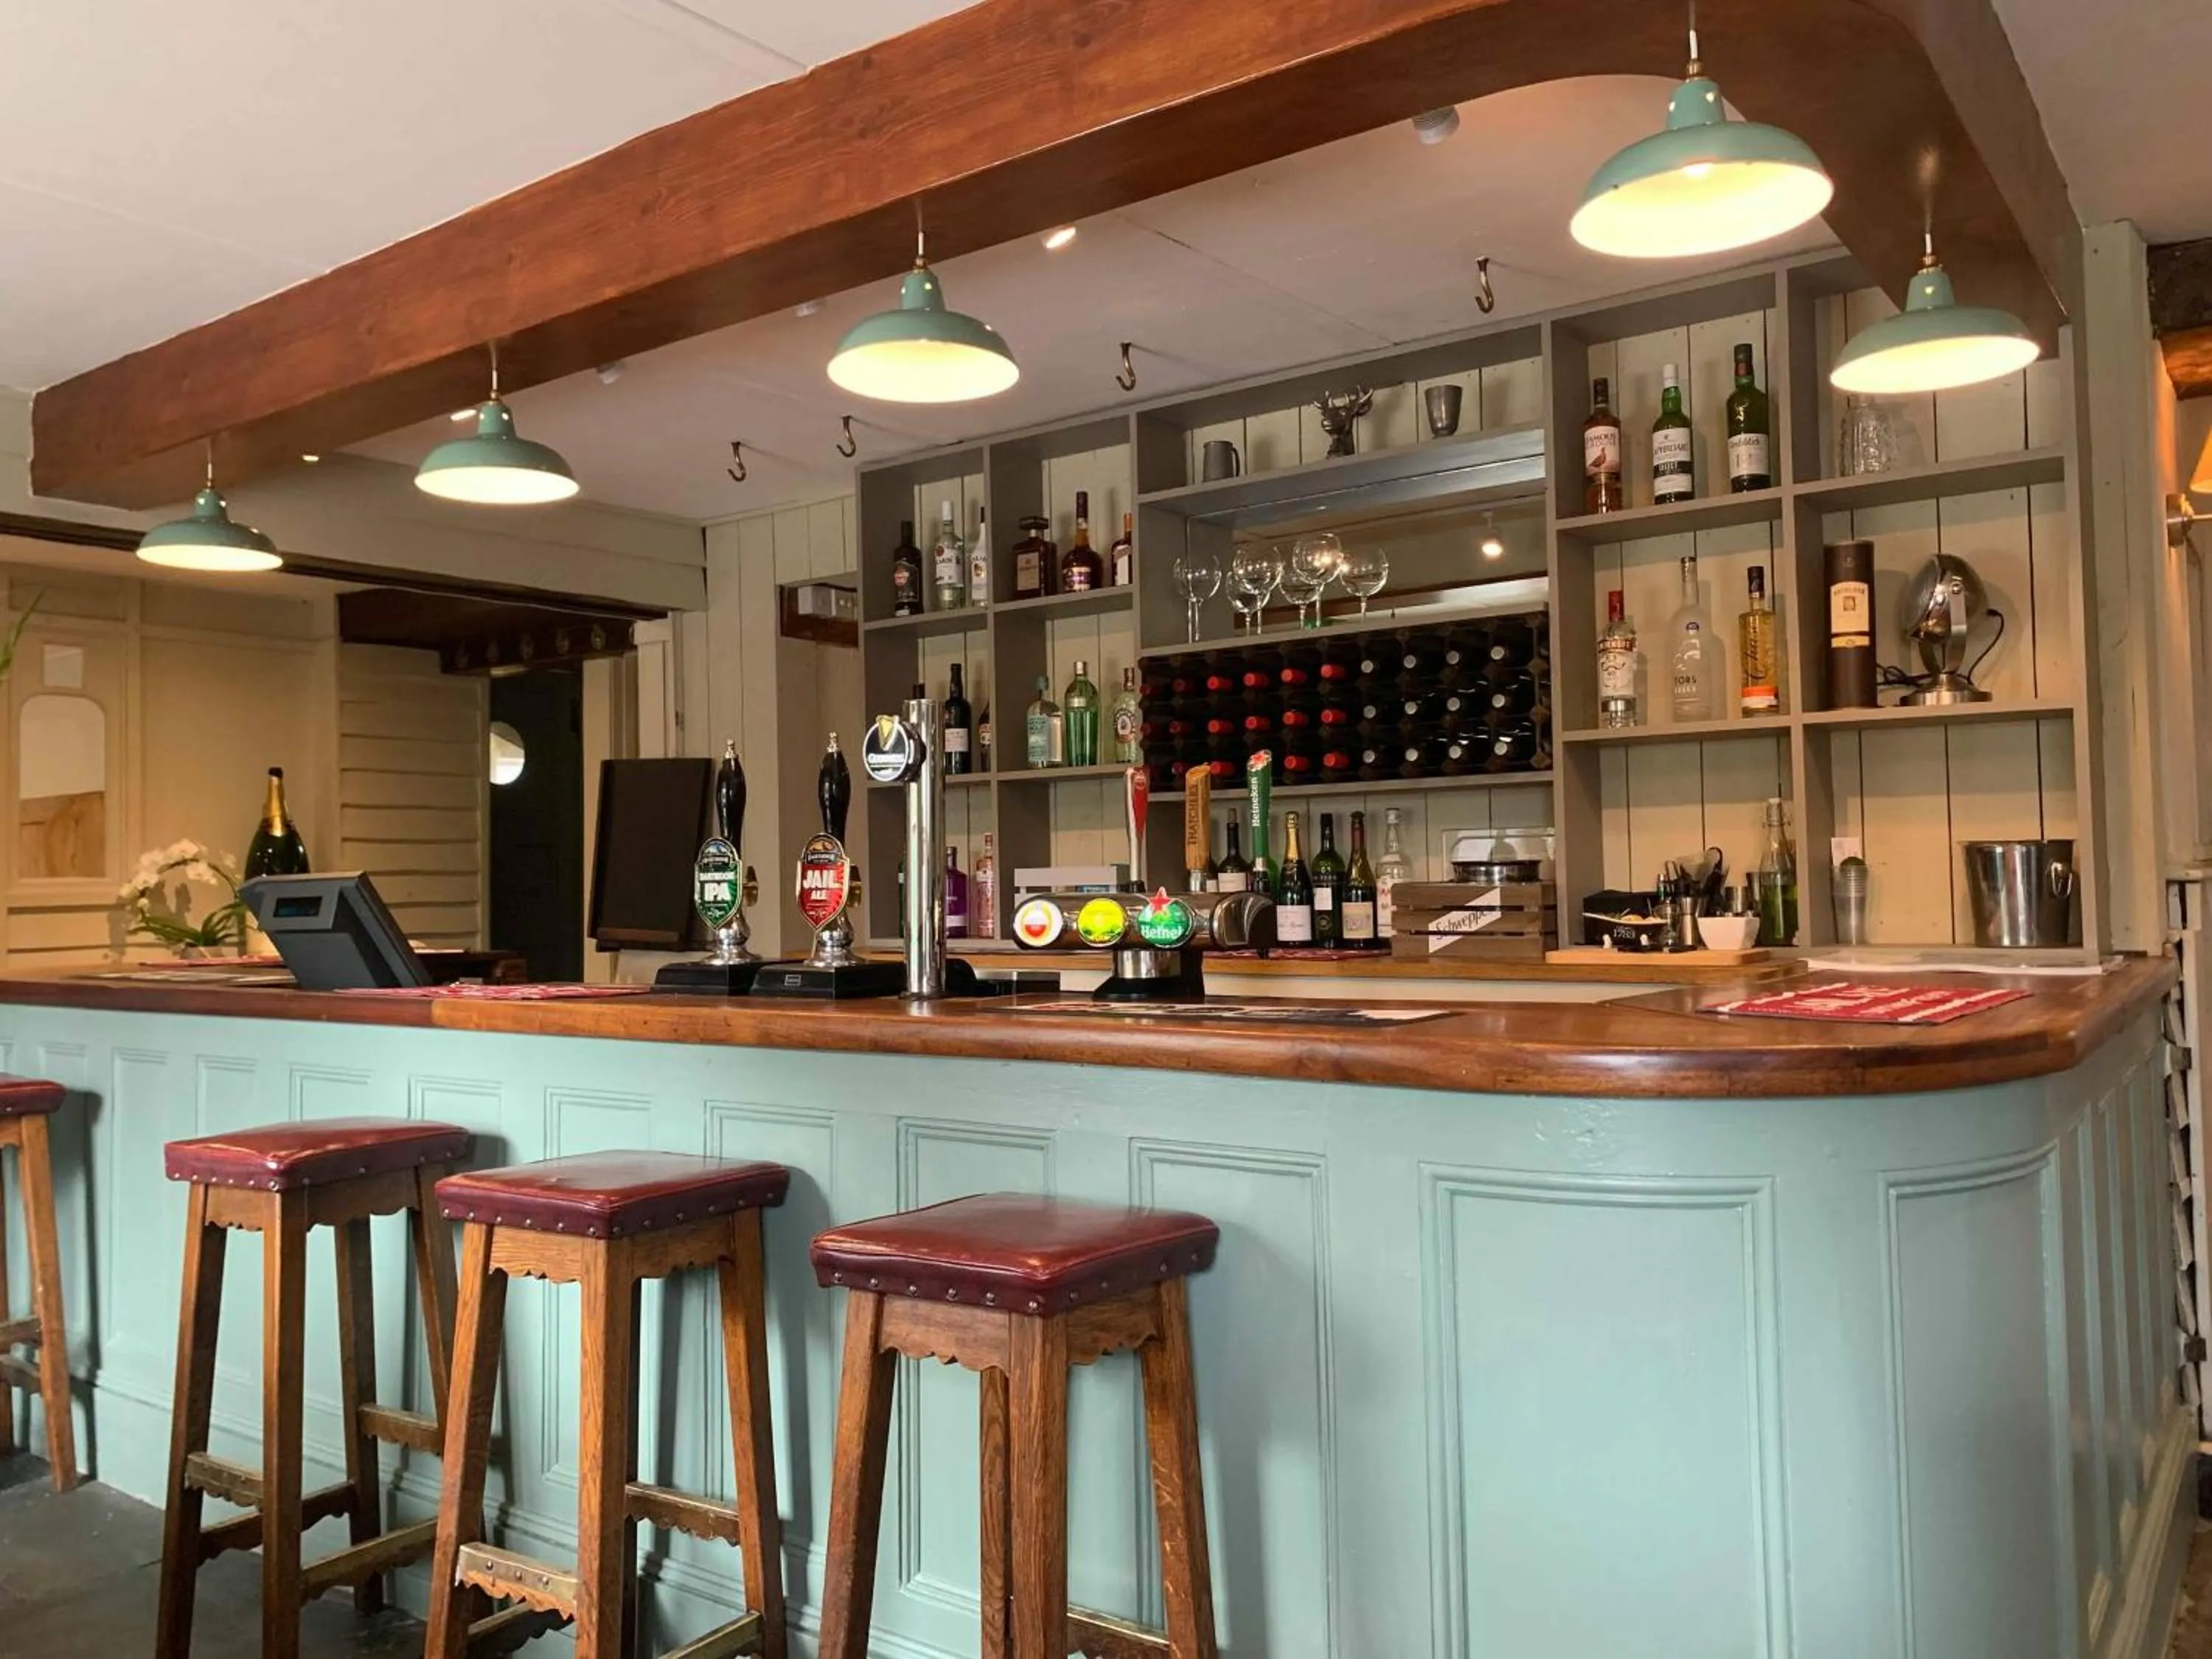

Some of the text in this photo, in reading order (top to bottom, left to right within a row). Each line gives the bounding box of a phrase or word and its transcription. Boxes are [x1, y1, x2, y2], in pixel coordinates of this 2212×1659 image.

[1251, 776, 1260, 827] Heineken
[803, 869, 840, 889] JAIL
[704, 883, 731, 902] IPA
[811, 891, 828, 900] ALE
[1436, 907, 1488, 940] Schwepp
[1613, 928, 1635, 939] 1783
